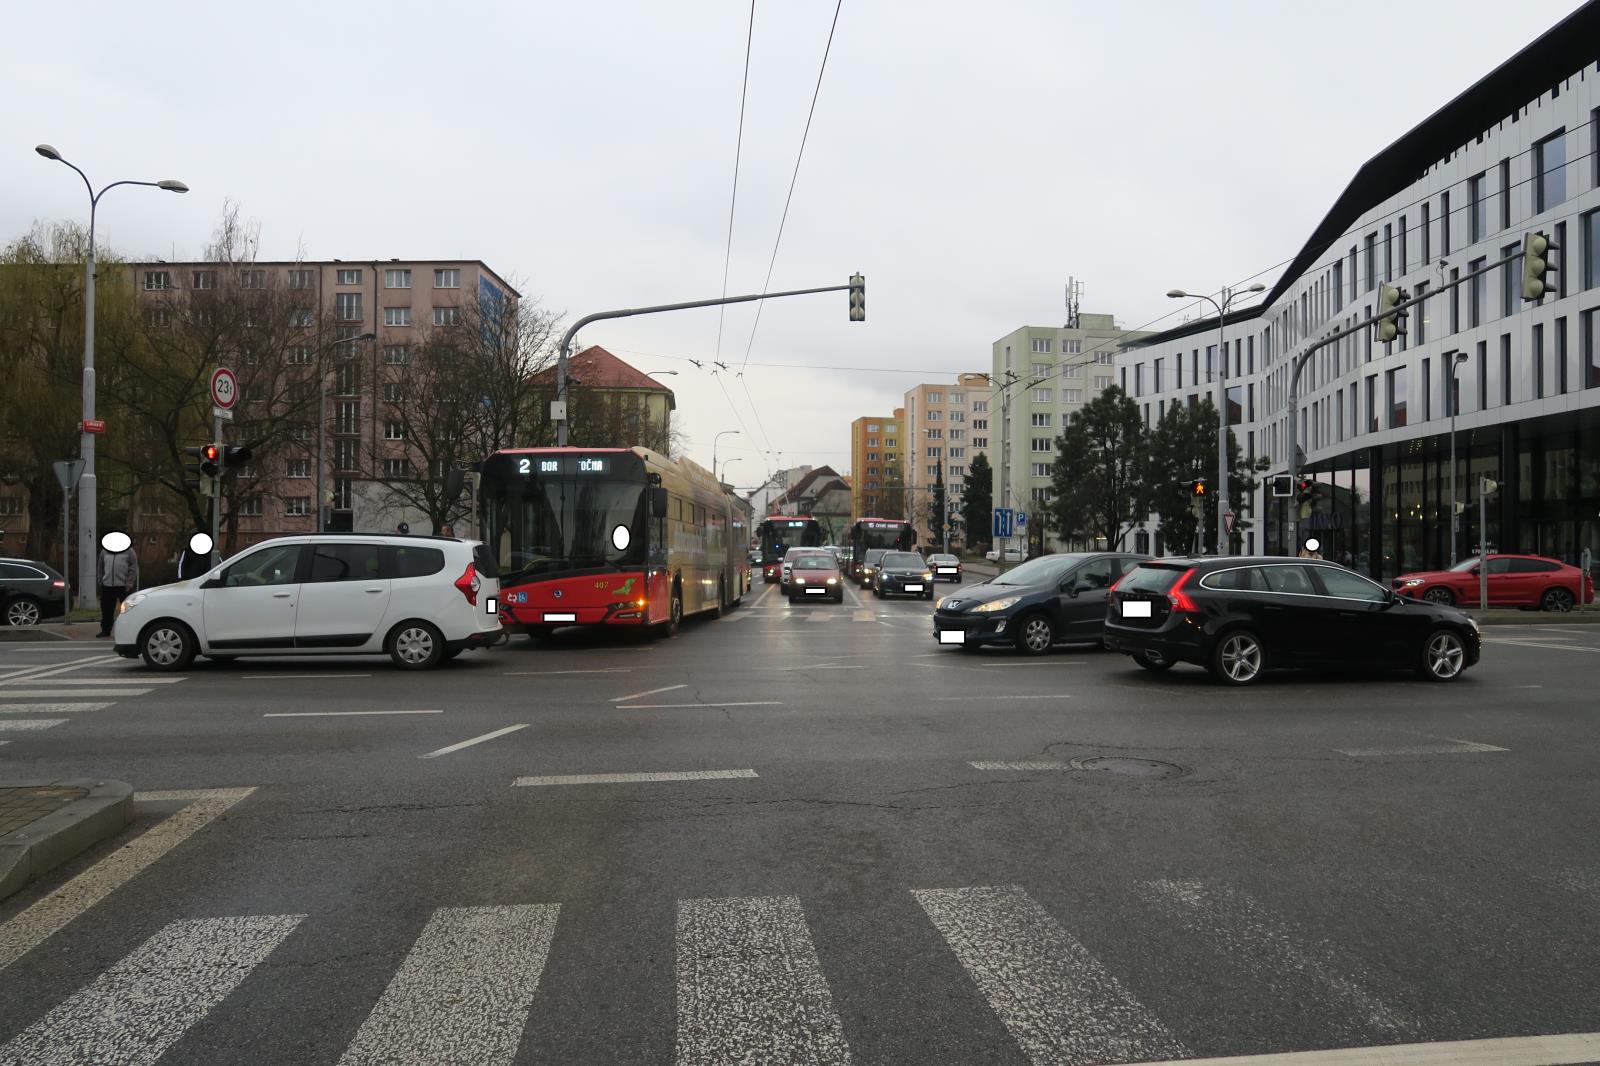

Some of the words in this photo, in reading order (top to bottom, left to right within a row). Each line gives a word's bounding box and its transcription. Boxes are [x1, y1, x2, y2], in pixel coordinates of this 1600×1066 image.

[519, 458, 530, 474] 2
[578, 458, 603, 471] OČNA
[1018, 513, 1024, 522] P
[594, 581, 609, 589] 407
